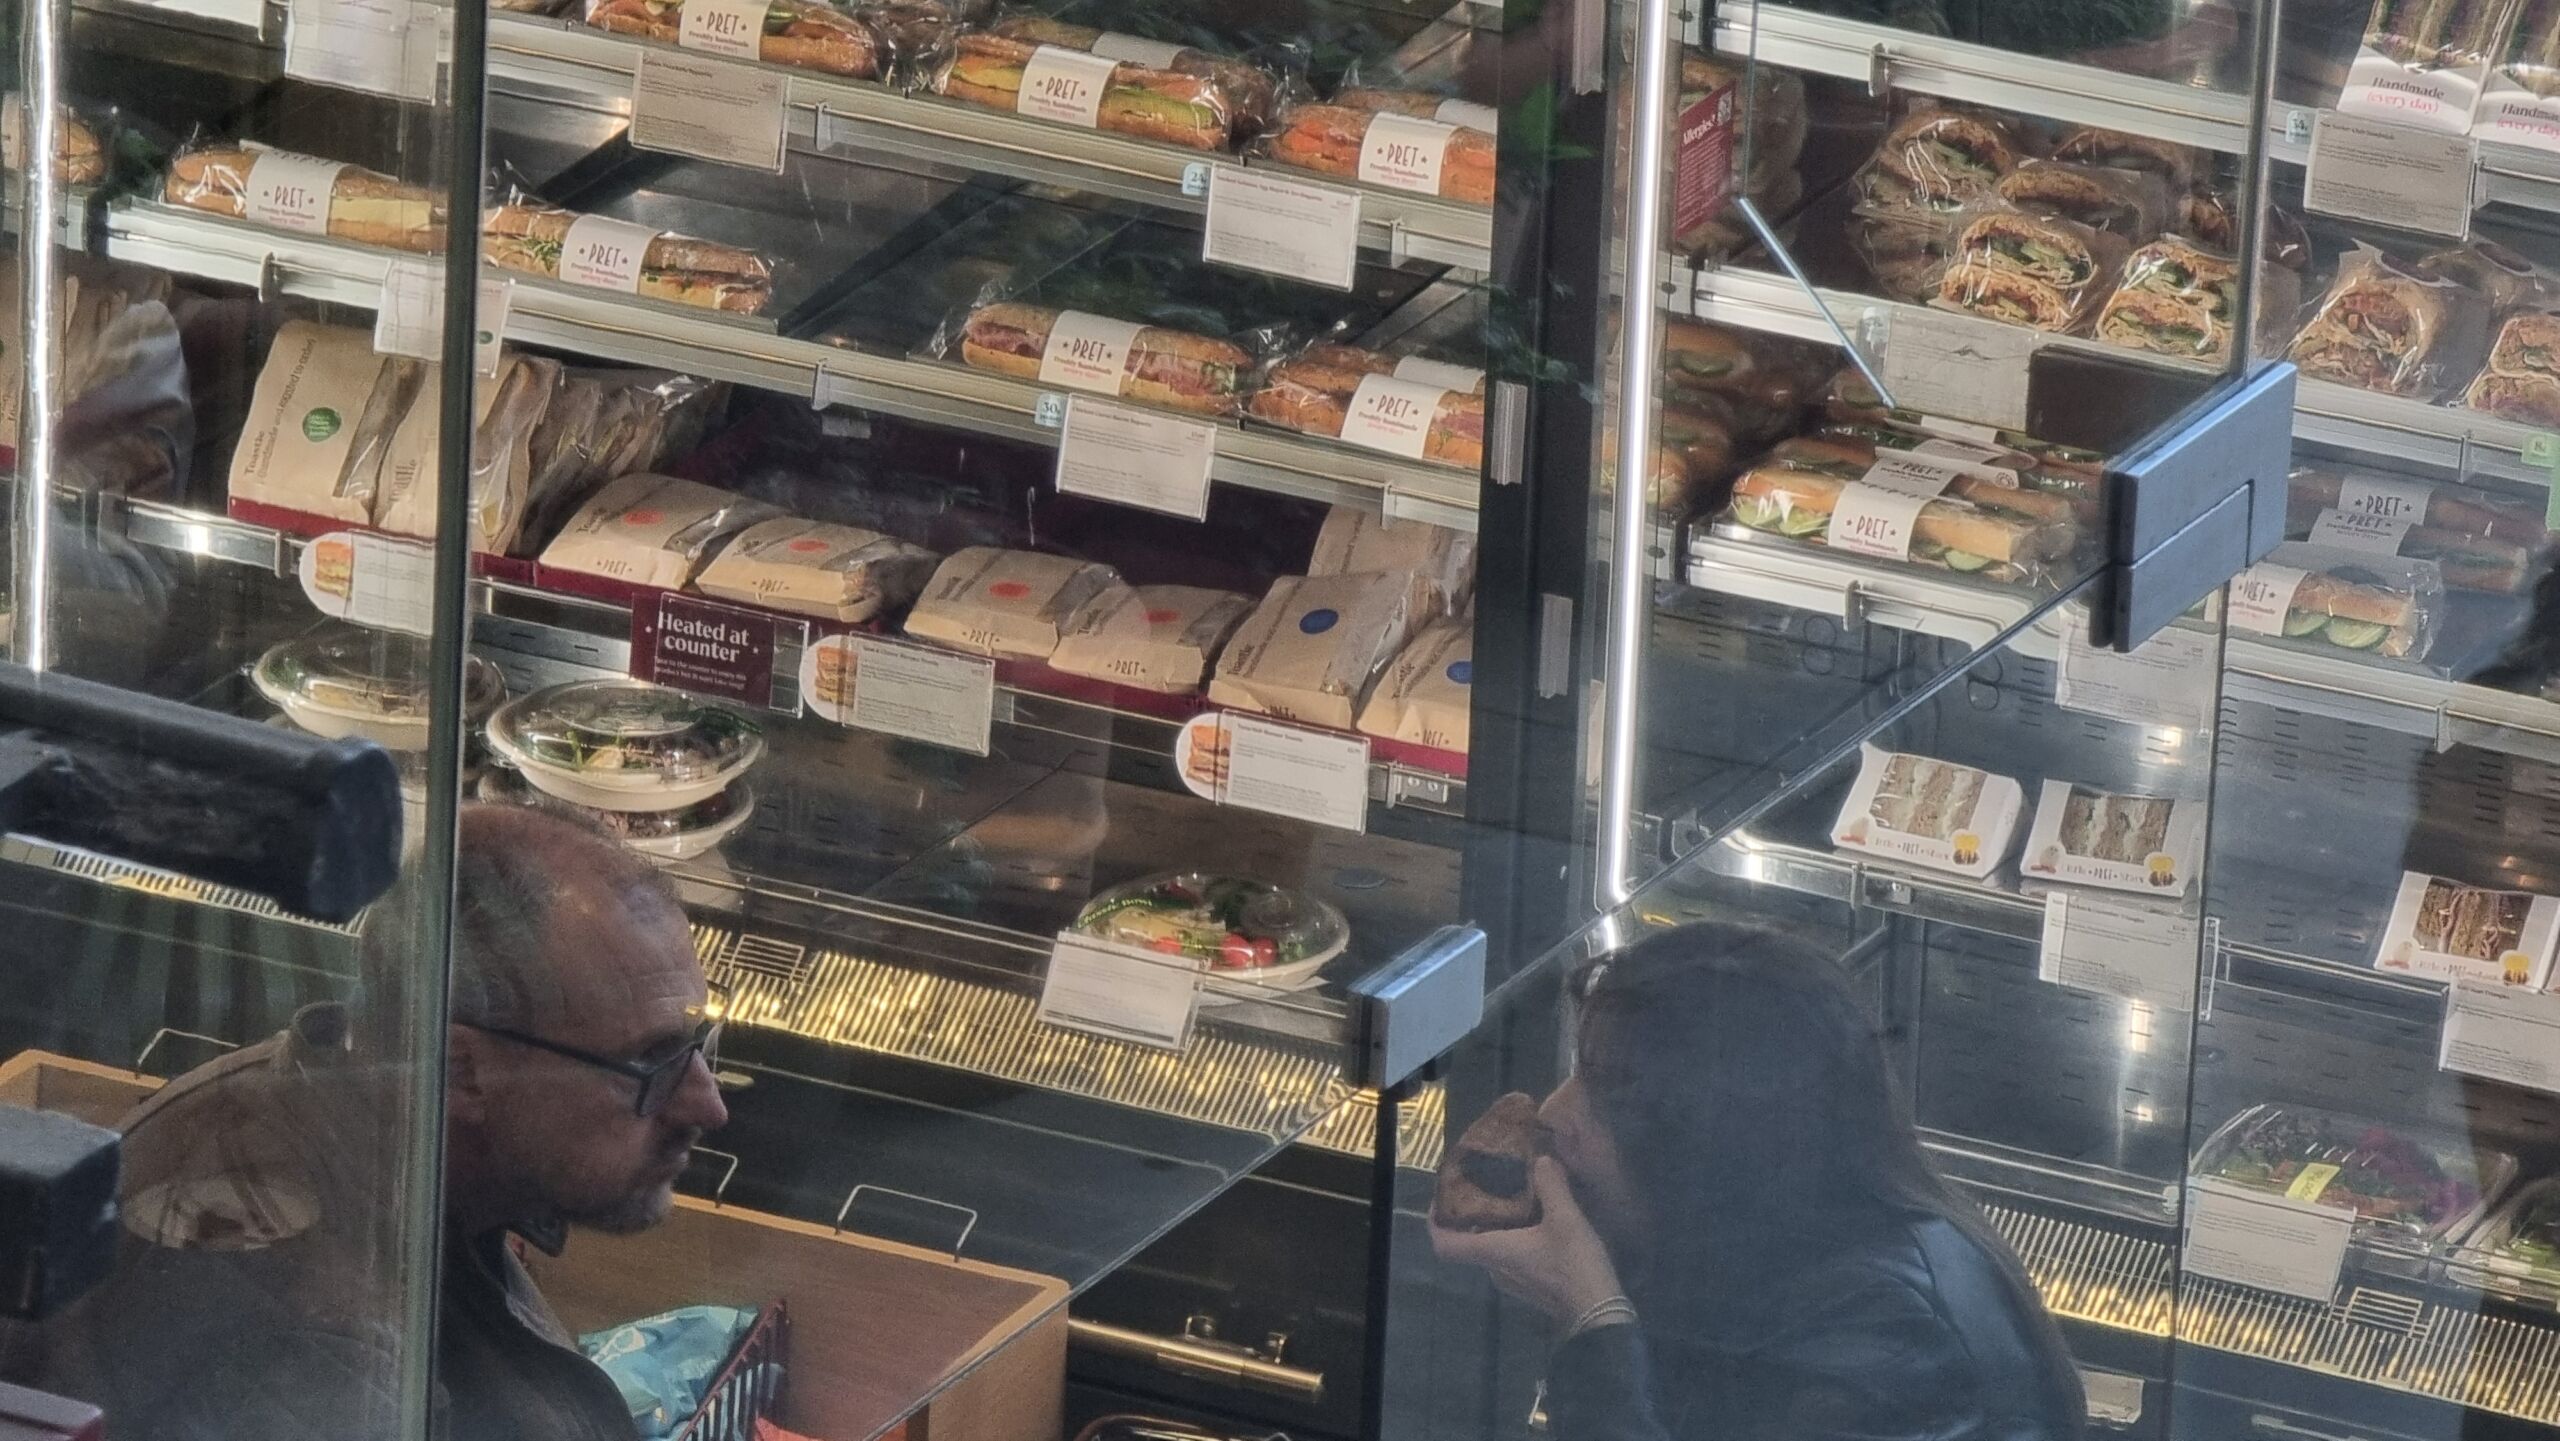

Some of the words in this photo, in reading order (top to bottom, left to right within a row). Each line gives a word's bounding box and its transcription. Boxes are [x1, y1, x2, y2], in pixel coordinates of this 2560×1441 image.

[706, 10, 740, 35] PRET
[1045, 76, 1080, 100] PRET
[2372, 77, 2445, 100] Handmade
[2367, 91, 2405, 109] (every
[2410, 98, 2438, 114] day)
[2497, 118, 2534, 134] (every
[1386, 142, 1420, 168] PRET
[274, 185, 306, 209] PRET
[588, 242, 621, 268] PRET
[1071, 337, 1106, 362] PRET
[1376, 394, 1412, 418] PRET
[244, 431, 265, 475] Toastie
[1902, 462, 1934, 475] PRET
[2365, 495, 2403, 517] PRET
[1856, 514, 1889, 540] PRET
[2346, 514, 2383, 529] PRET
[601, 559, 628, 576] PRET
[759, 578, 785, 592] PRET
[658, 610, 725, 641] Heated
[729, 629, 750, 647] at
[969, 628, 995, 646] PRET
[664, 635, 740, 663] counter
[1115, 659, 1140, 676] PRET
